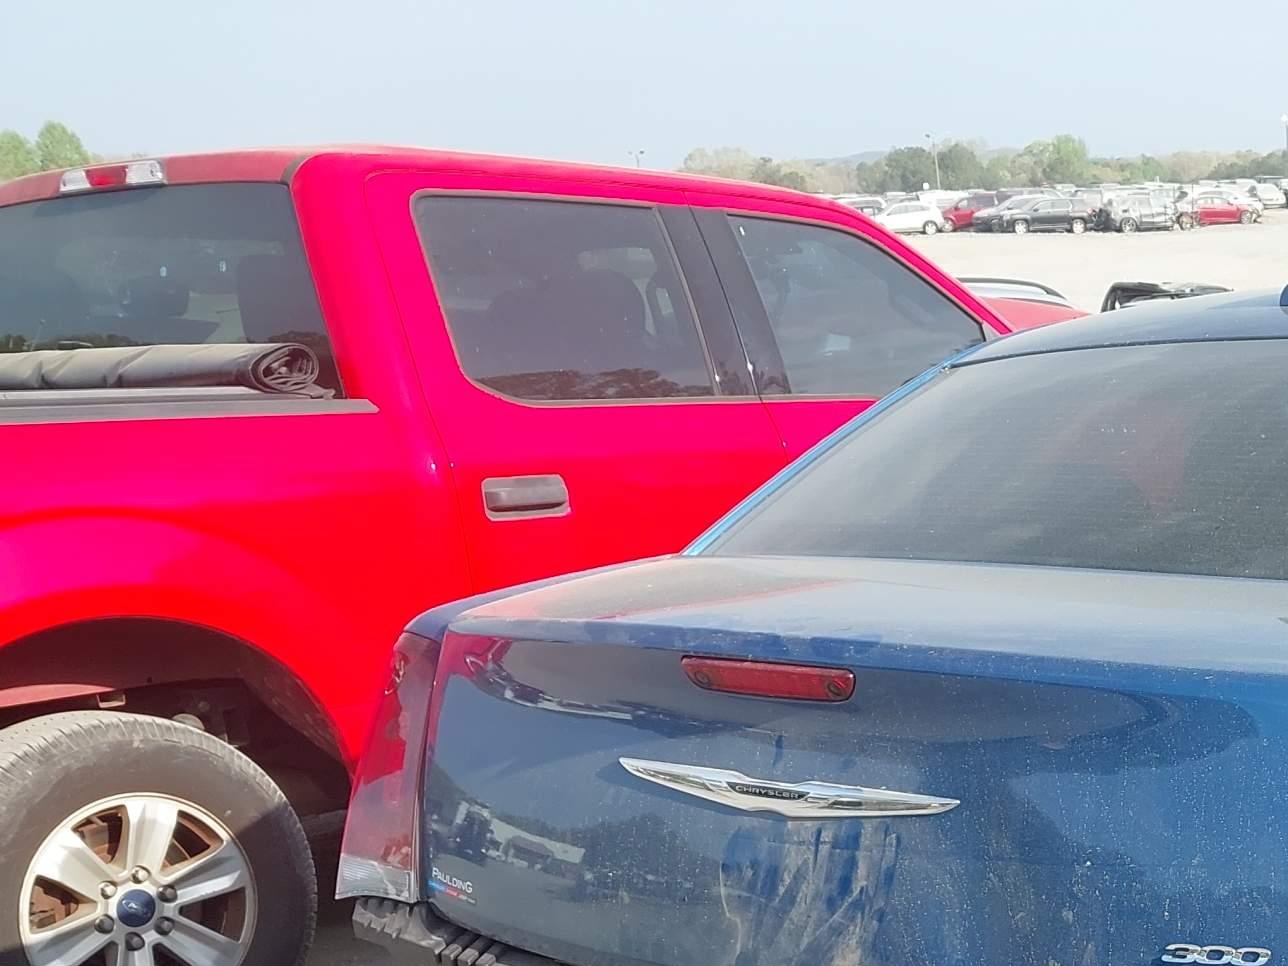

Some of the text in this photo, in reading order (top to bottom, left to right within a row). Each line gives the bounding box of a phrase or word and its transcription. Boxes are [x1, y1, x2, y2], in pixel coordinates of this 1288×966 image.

[735, 784, 799, 799] CHRYSLER
[431, 866, 474, 894] PAULDING
[1161, 943, 1272, 966] 300
